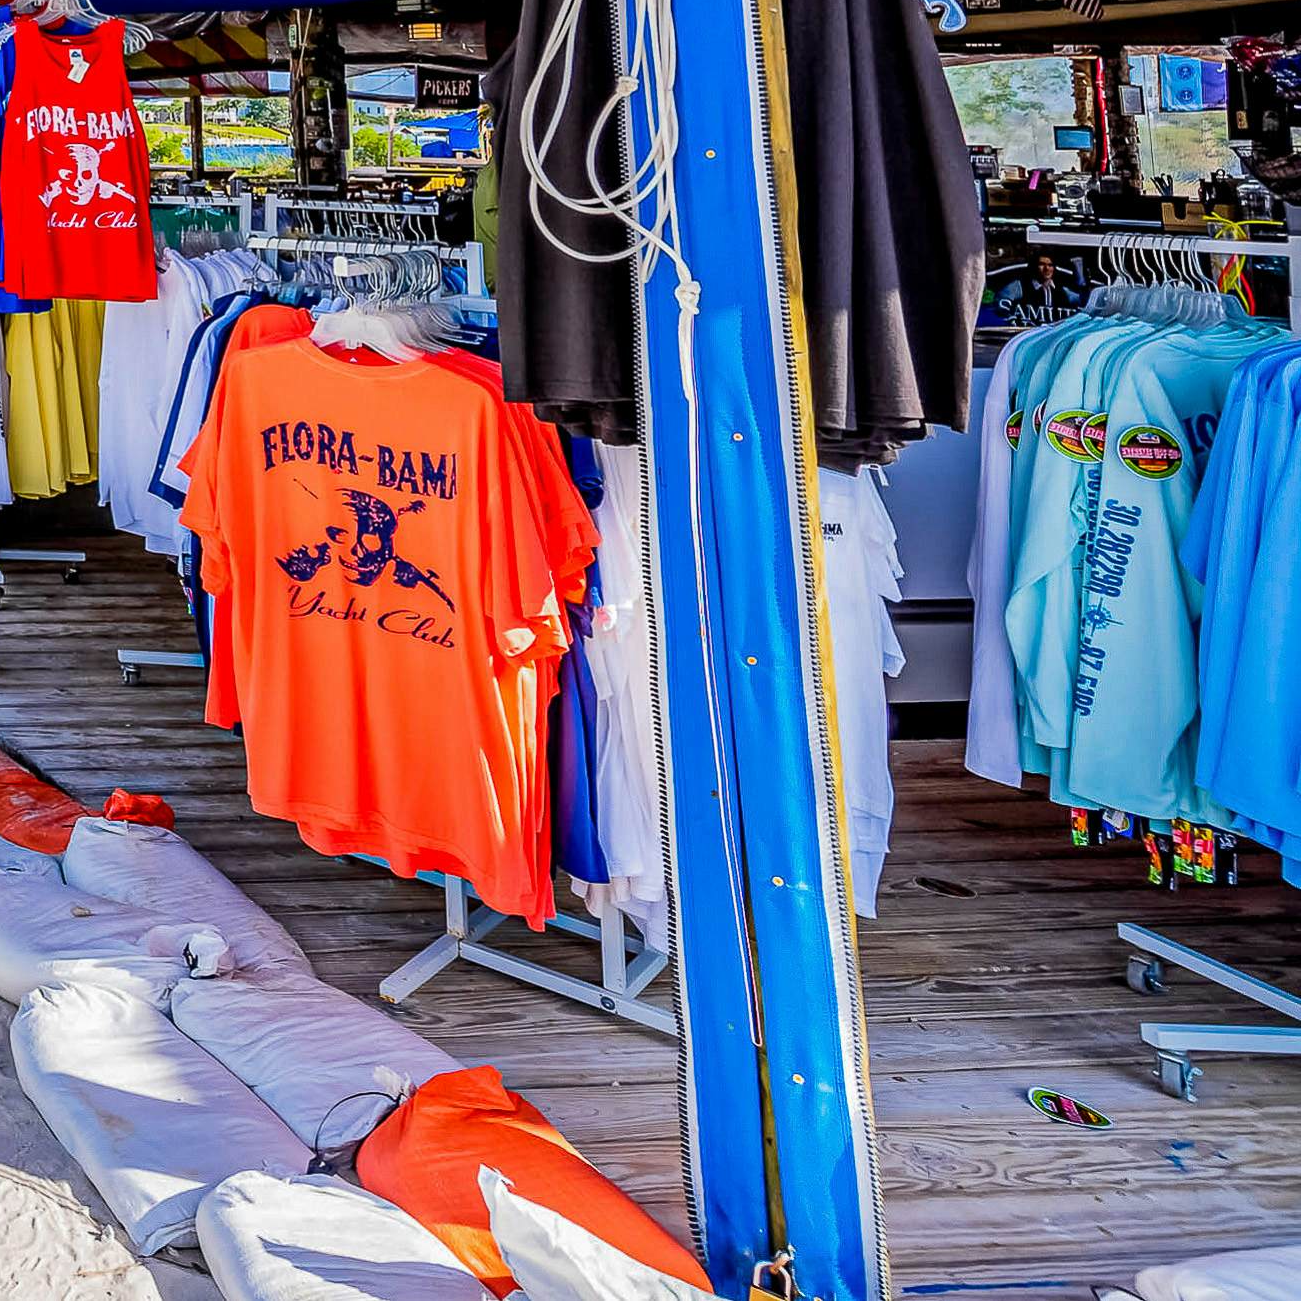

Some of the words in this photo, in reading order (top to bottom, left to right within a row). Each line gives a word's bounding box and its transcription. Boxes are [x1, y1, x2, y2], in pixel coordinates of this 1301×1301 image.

[423, 79, 471, 96] PICKERS
[95, 210, 138, 229] Club
[288, 585, 367, 621] Yacht
[377, 609, 455, 649] Club
